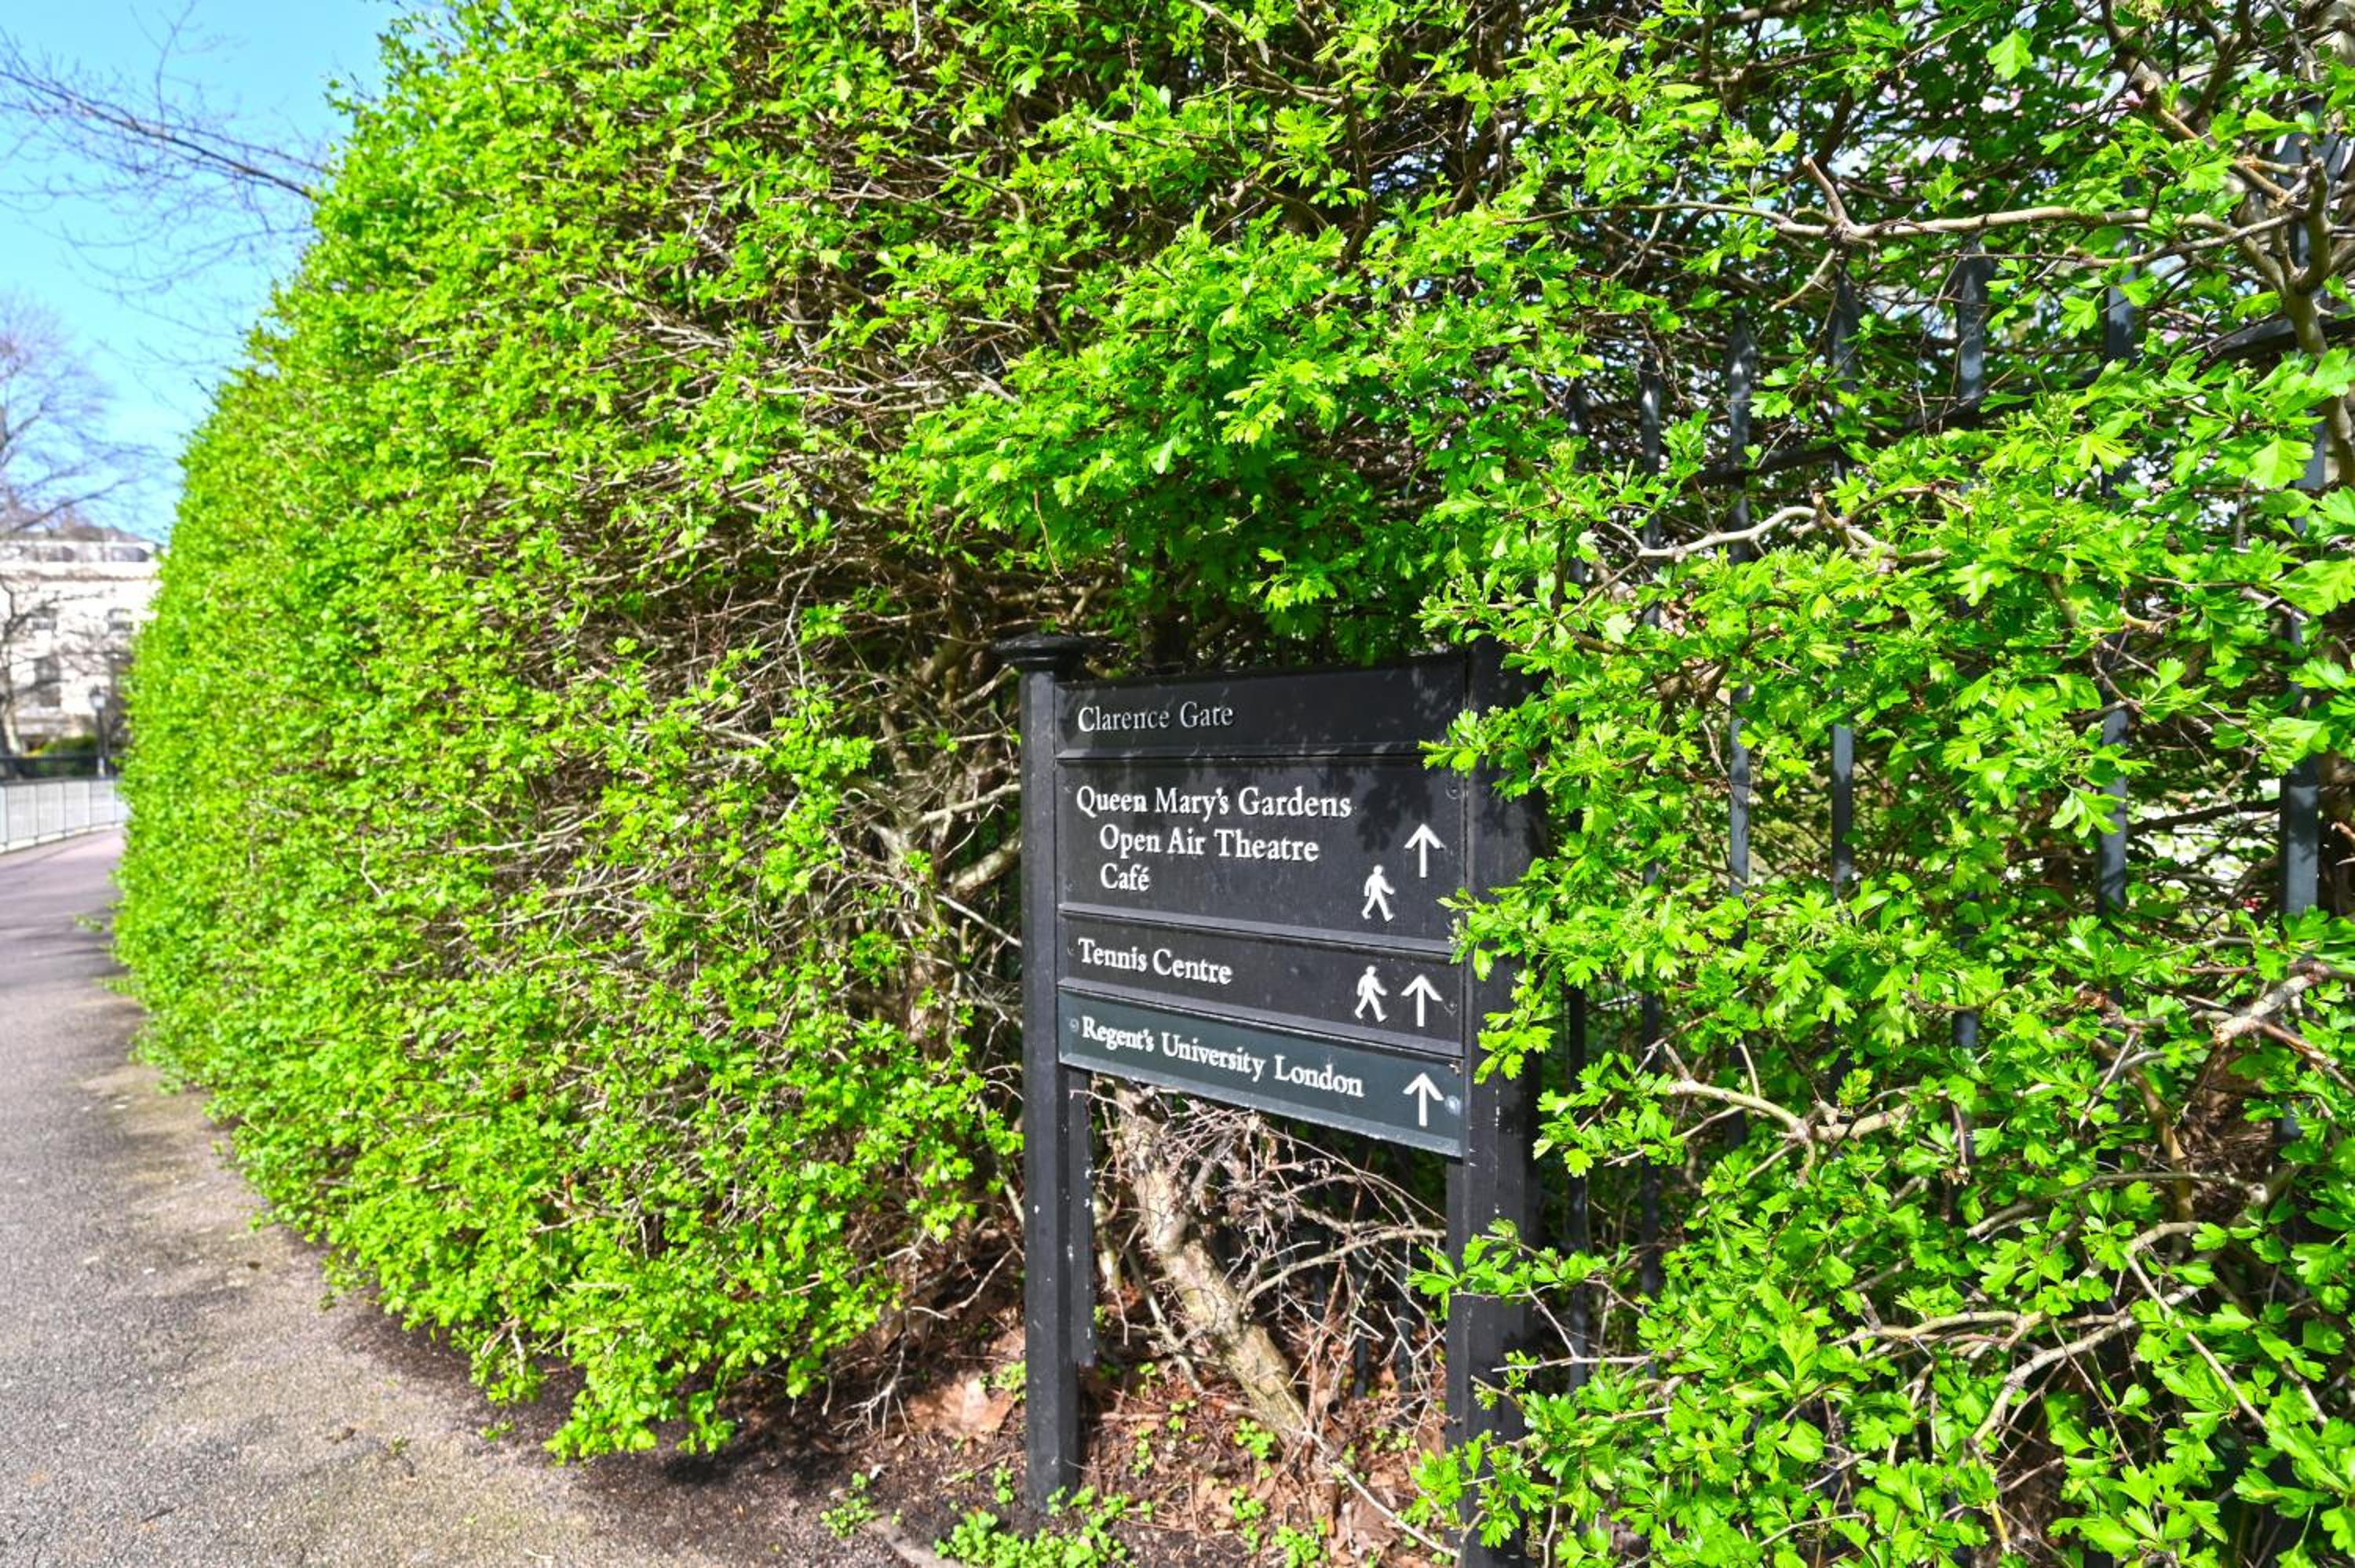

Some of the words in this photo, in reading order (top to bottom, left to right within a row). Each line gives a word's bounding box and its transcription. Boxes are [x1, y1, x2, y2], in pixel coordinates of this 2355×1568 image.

[1078, 706, 1170, 732] Clarence
[1180, 701, 1233, 727] Gate
[1076, 786, 1147, 819] Queen
[1155, 787, 1229, 822] Mary's
[1238, 786, 1352, 819] Gardens
[1100, 823, 1160, 859] Open
[1167, 826, 1206, 855] Air
[1214, 829, 1320, 862] Theatre
[1100, 864, 1150, 892] Café
[1078, 938, 1147, 971] Tennis
[1152, 949, 1233, 986] Centre
[1082, 1017, 1155, 1052] Regent's
[1162, 1033, 1265, 1081] University
[1275, 1056, 1364, 1098] London
